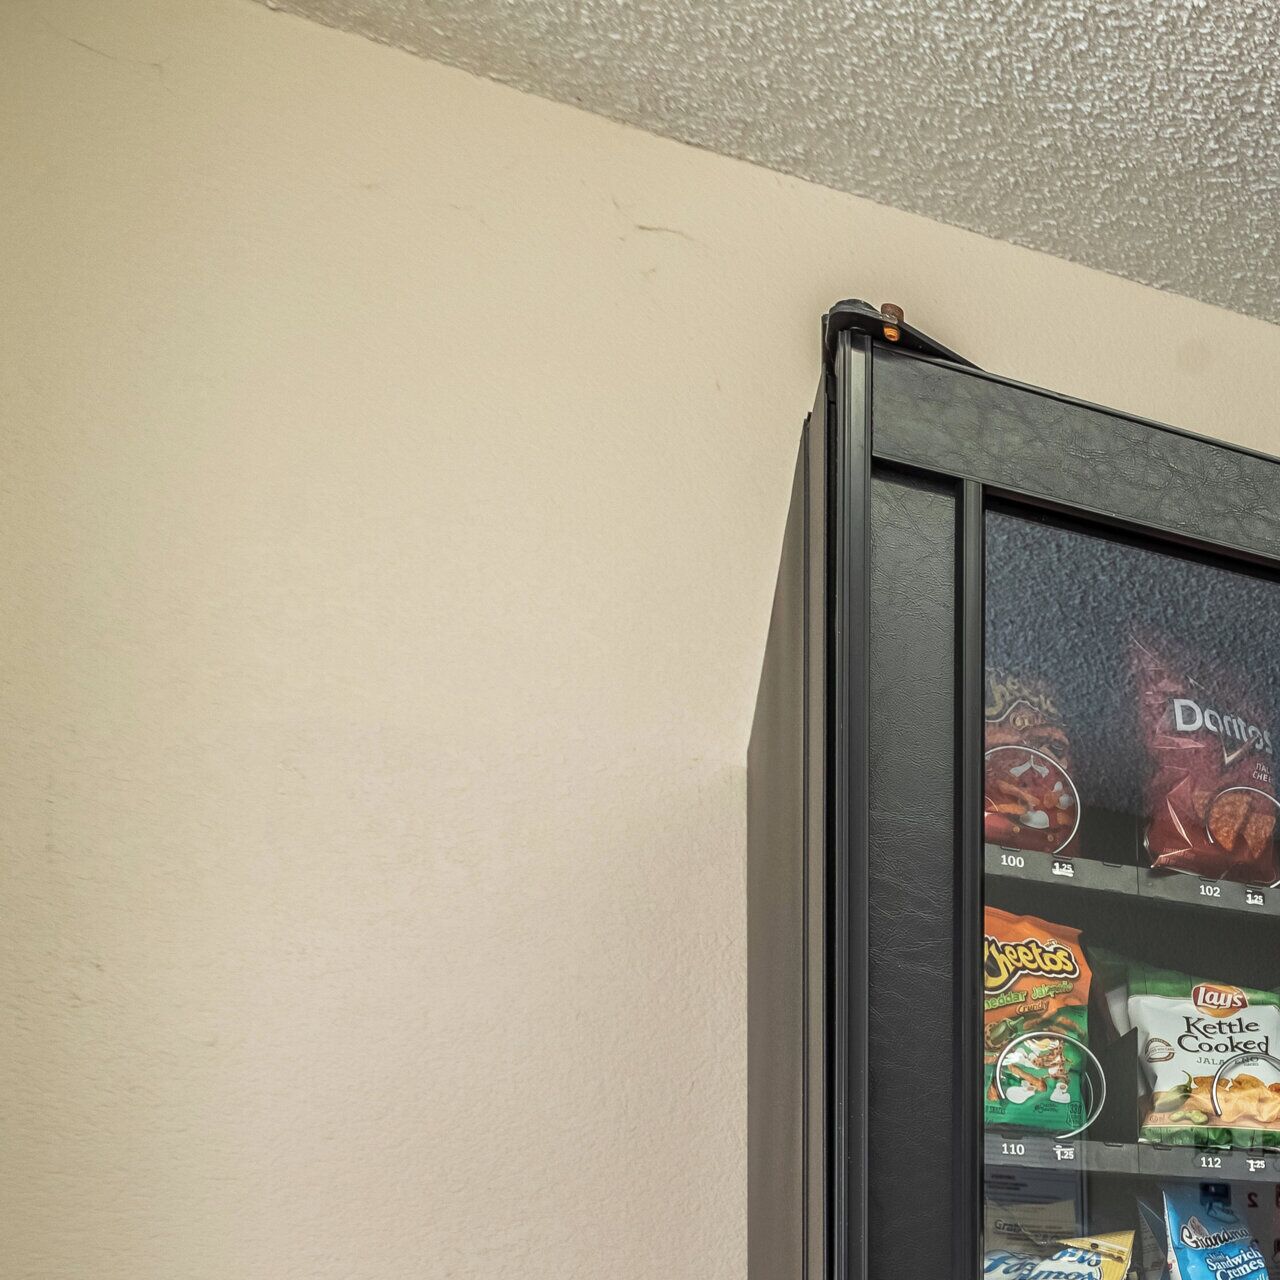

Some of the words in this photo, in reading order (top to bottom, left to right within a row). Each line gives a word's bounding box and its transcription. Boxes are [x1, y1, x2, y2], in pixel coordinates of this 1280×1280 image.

[1172, 699, 1272, 754] Doritos
[1001, 855, 1024, 868] 100
[1200, 886, 1220, 896] 102
[1184, 1016, 1260, 1036] Kettle
[1176, 1035, 1270, 1055] Cooked
[1002, 1144, 1024, 1155] 110
[1200, 1158, 1221, 1168] 112
[1206, 1247, 1263, 1271] Sandwich
